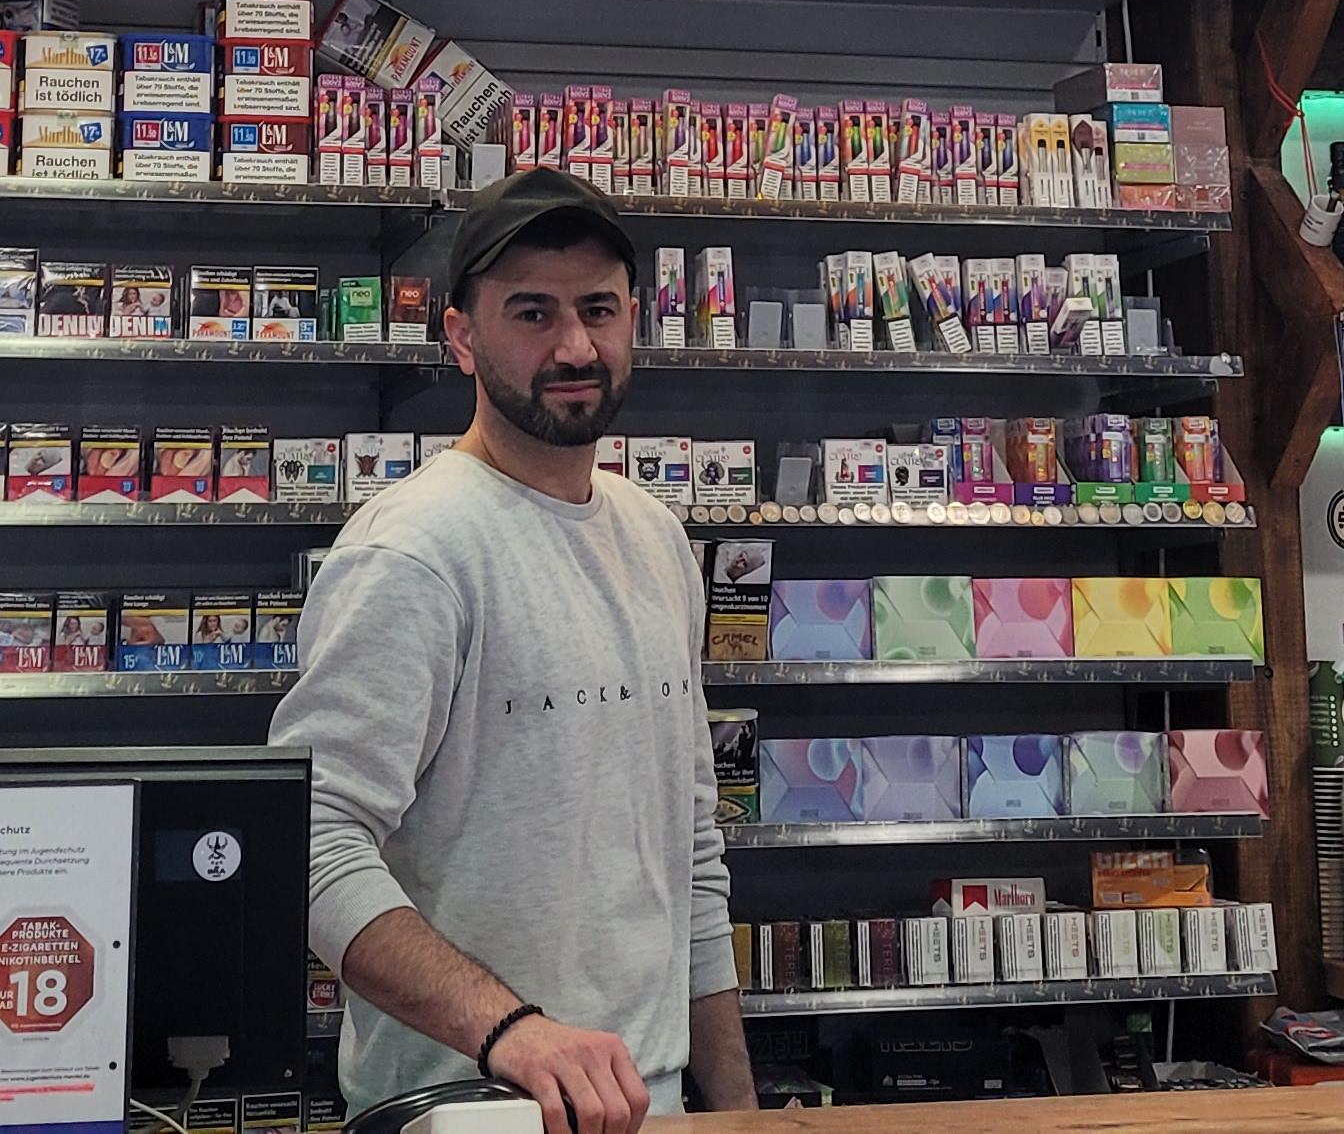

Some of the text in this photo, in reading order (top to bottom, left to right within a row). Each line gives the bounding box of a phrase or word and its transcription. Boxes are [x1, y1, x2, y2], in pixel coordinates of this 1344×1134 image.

[39, 75, 100, 90] Rauchen
[35, 90, 103, 103] ist tödlich
[448, 80, 500, 136] Rauchen
[12, 929, 69, 940] PRODUKTE
[1, 942, 79, 953] E-ZIGARETTEN
[9, 969, 68, 1017] 18
[0, 1001, 13, 1010] AB
